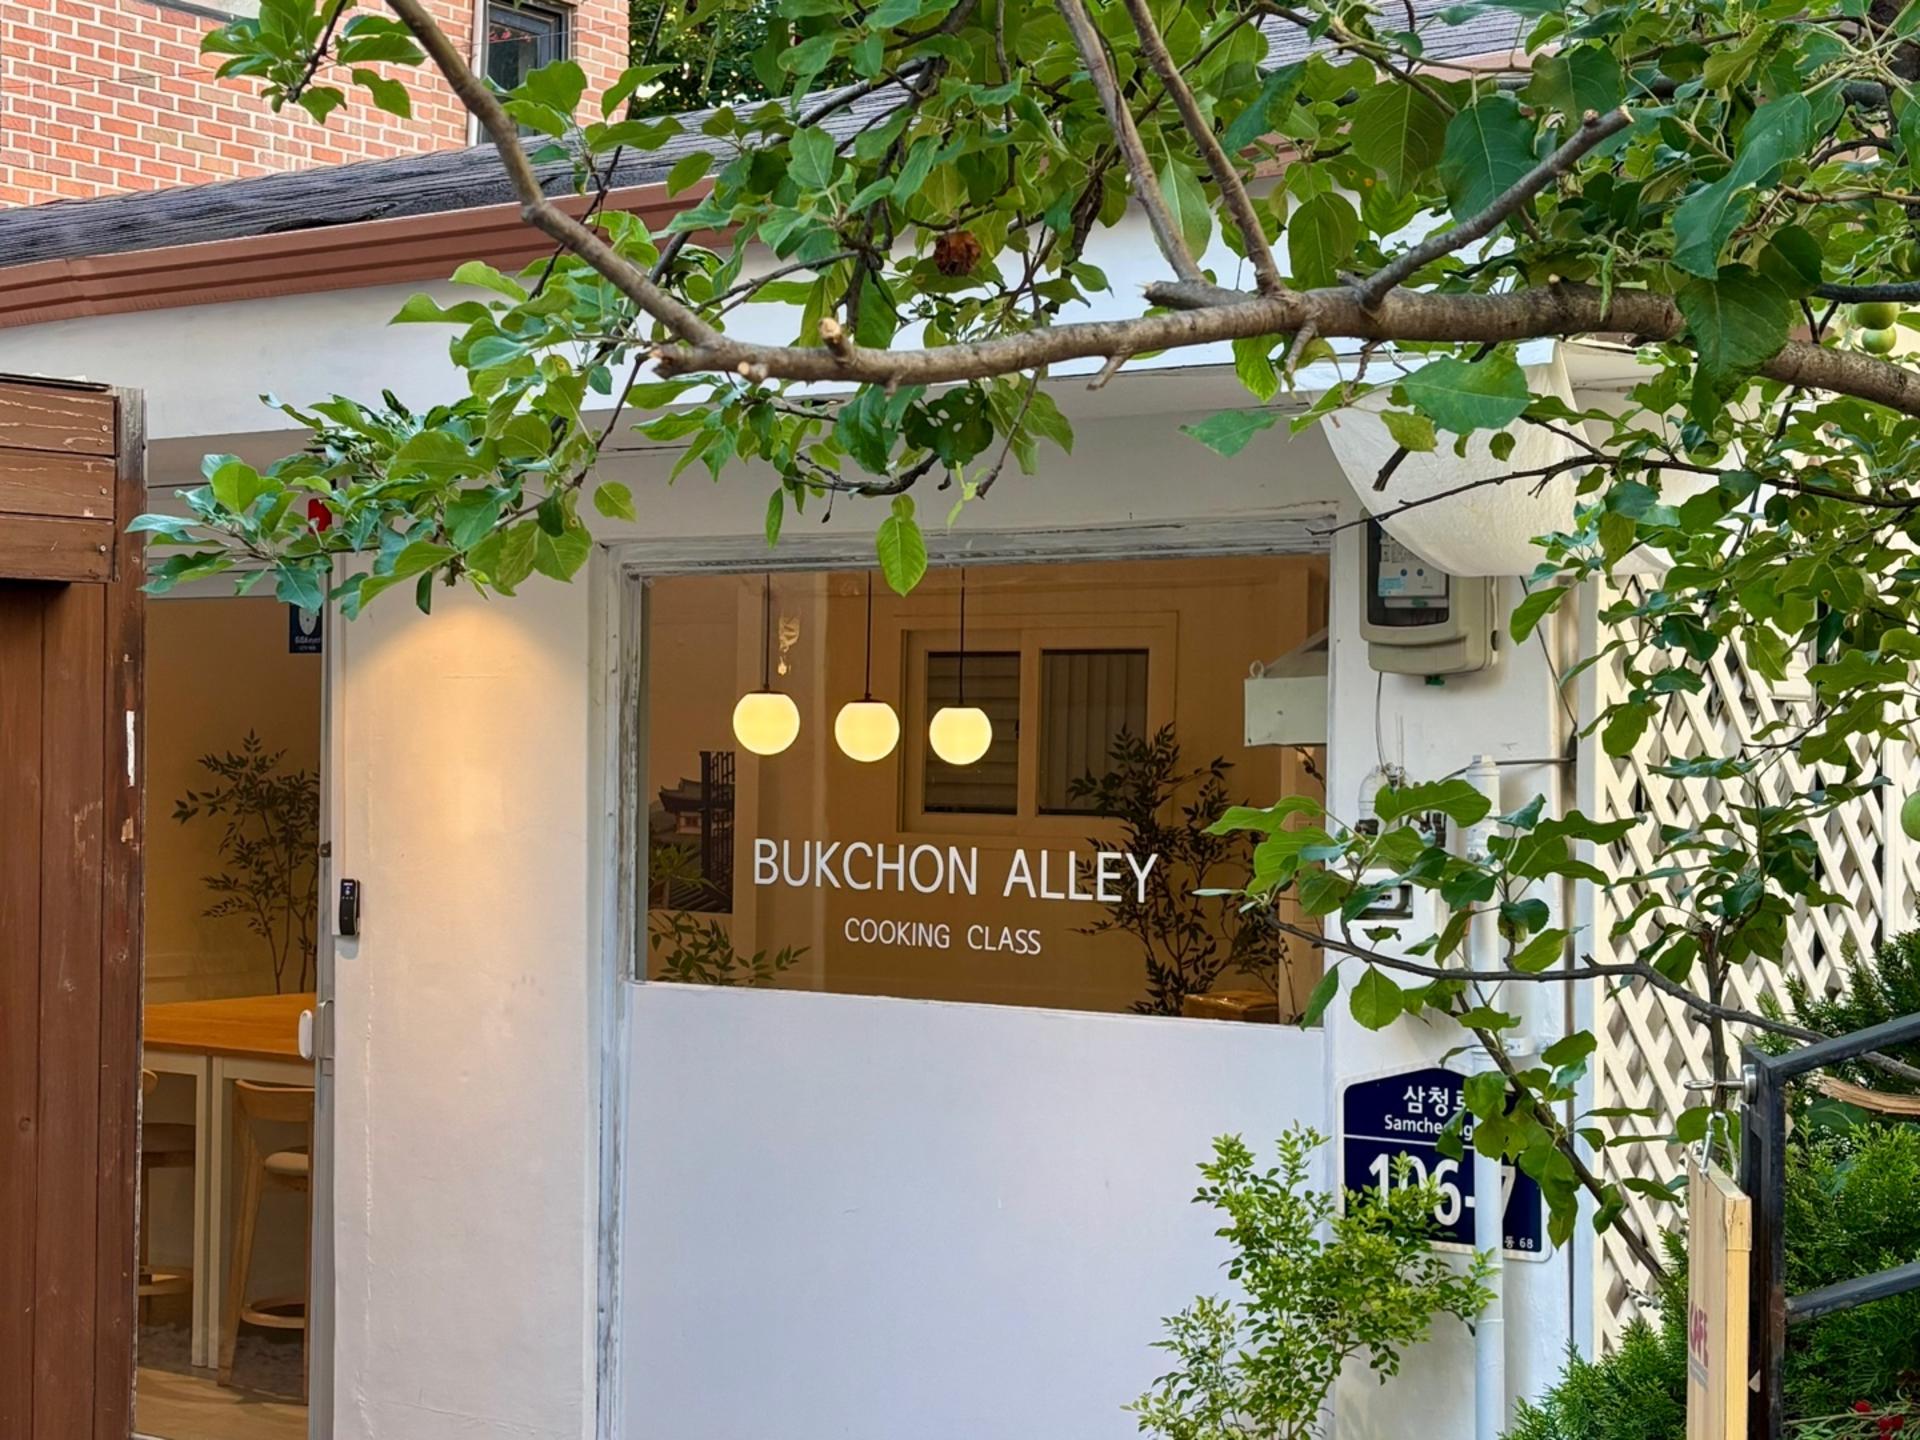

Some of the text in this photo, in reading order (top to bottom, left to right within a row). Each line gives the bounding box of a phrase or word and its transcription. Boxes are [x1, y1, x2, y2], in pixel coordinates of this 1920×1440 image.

[753, 838, 1158, 903] BUKCHON ALLEY
[845, 918, 1041, 955] COOKING CLASS
[1519, 1237, 1534, 1249] 68
